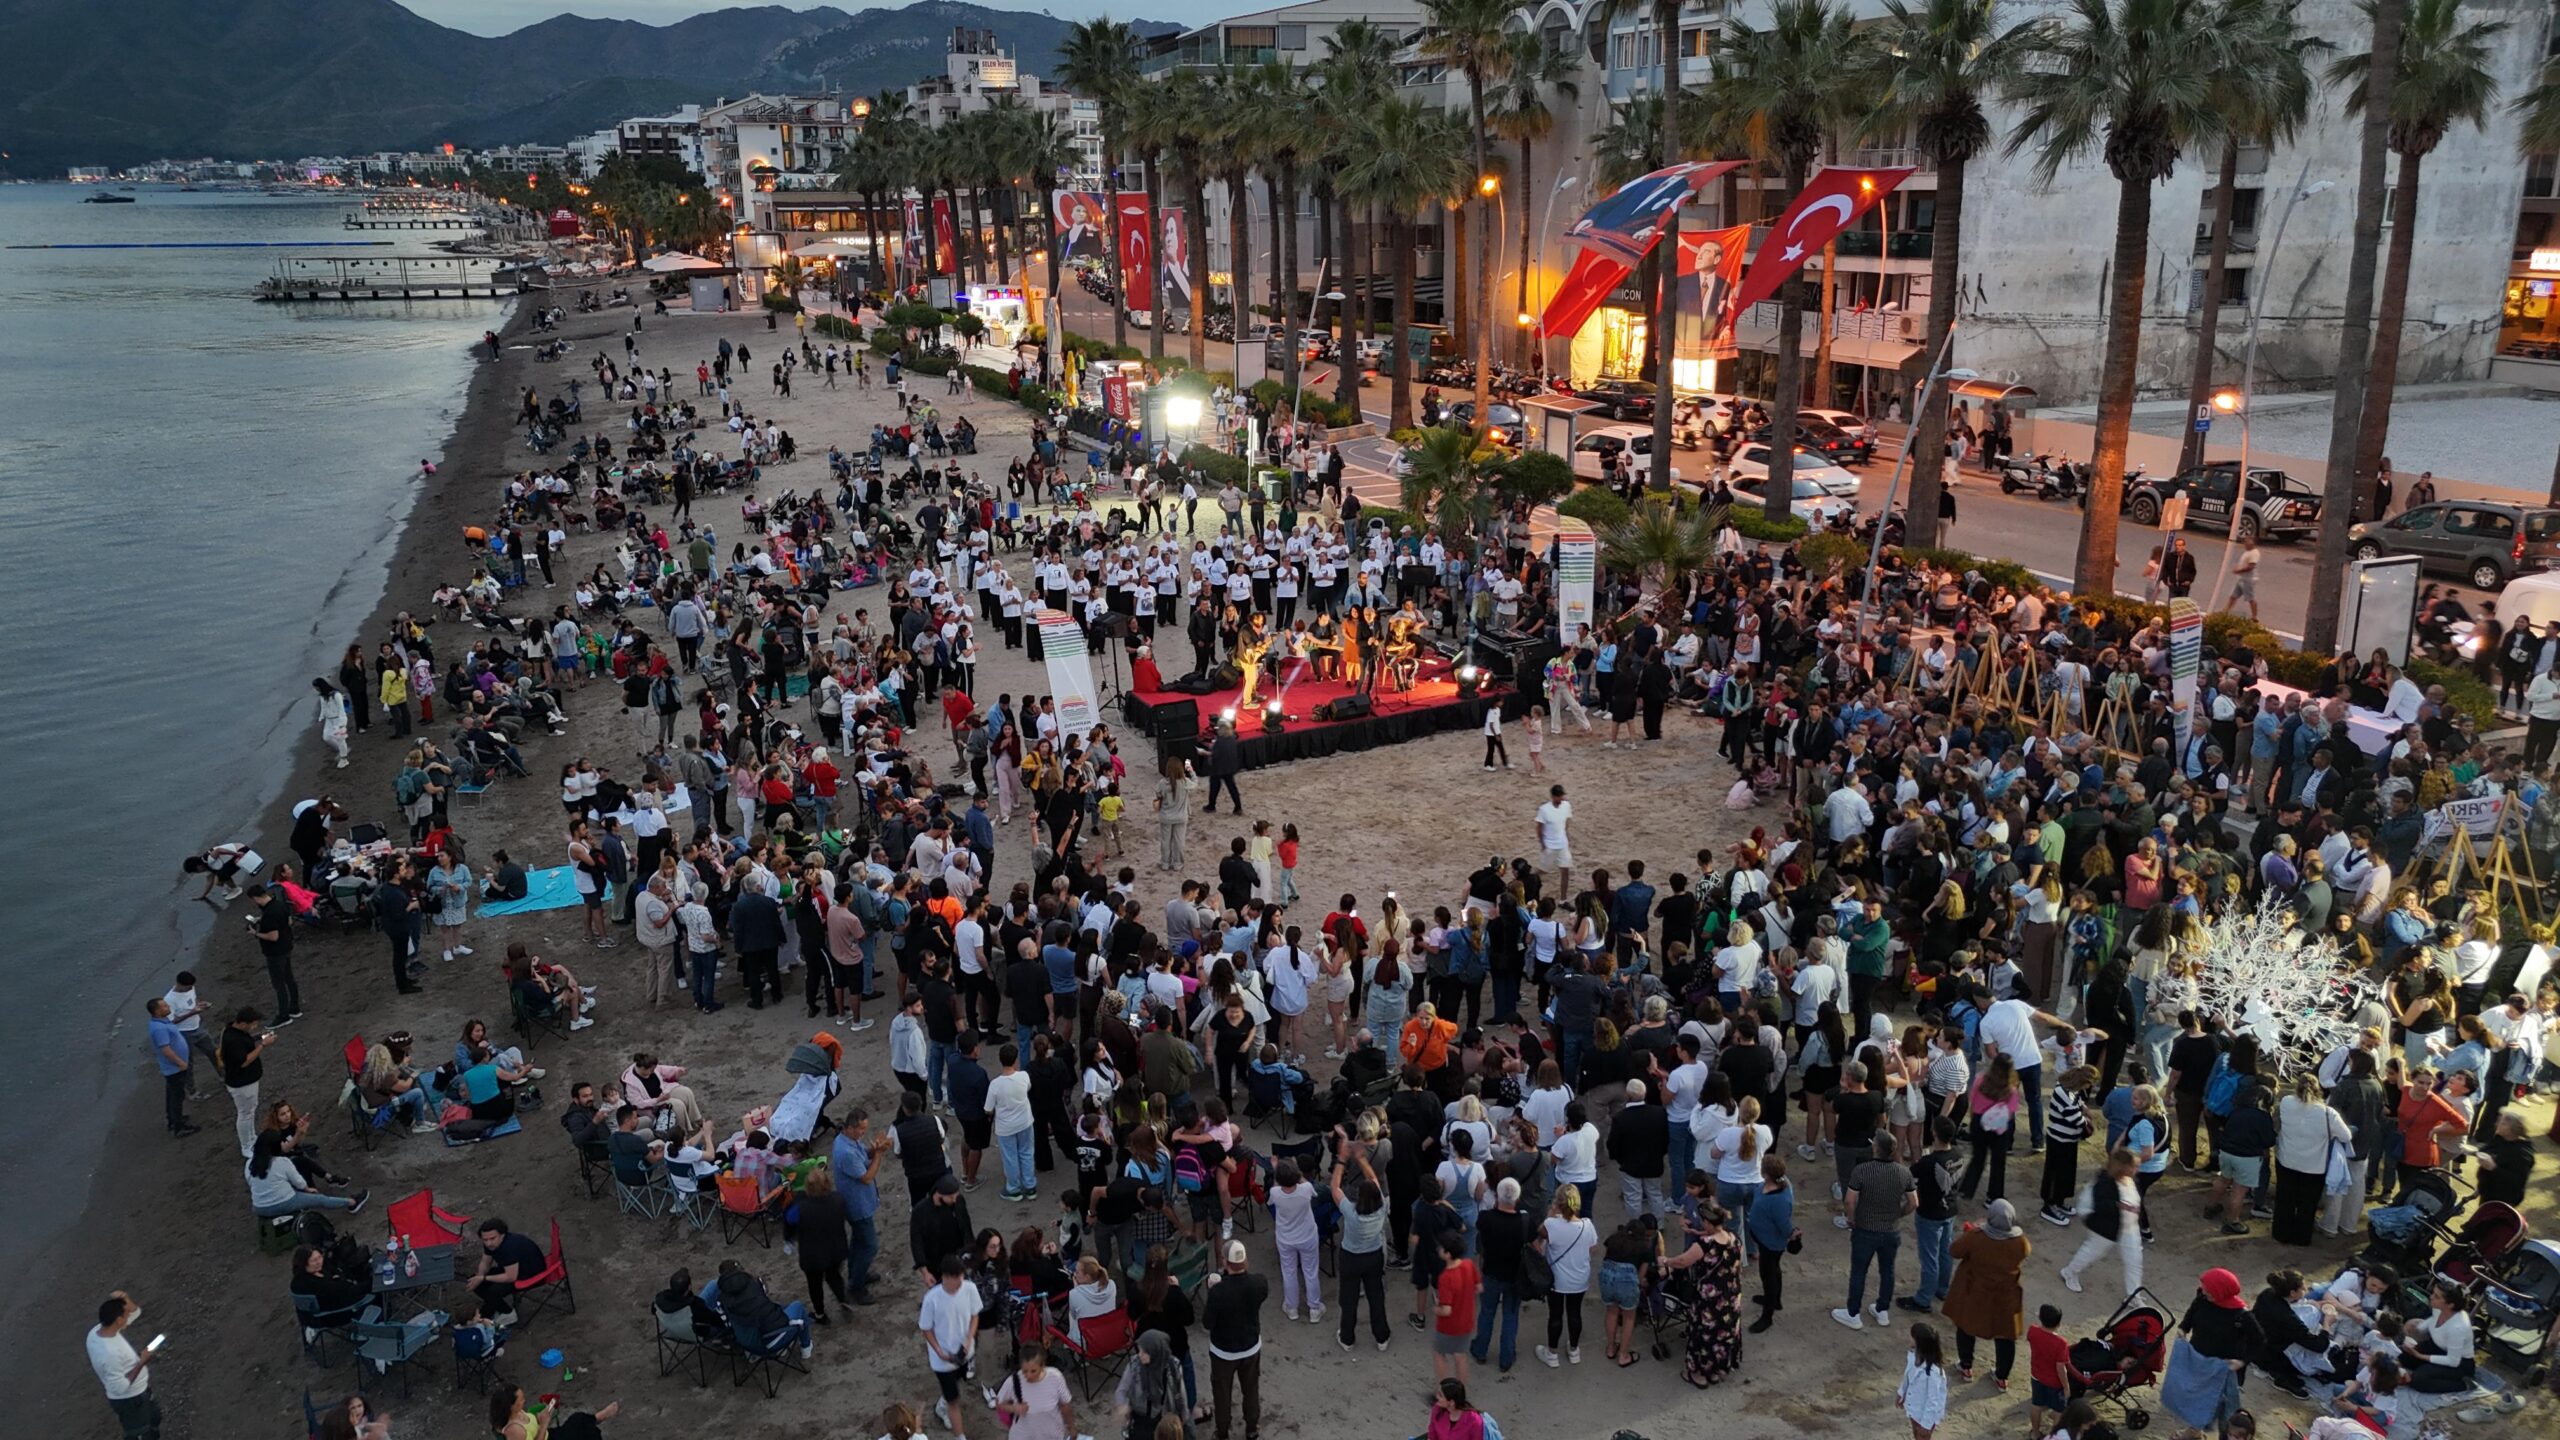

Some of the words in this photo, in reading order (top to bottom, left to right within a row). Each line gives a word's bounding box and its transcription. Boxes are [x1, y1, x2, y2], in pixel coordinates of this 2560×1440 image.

[1621, 289, 1642, 301] ICON
[1110, 383, 1125, 416] Coca-Cola
[2200, 406, 2208, 419] D
